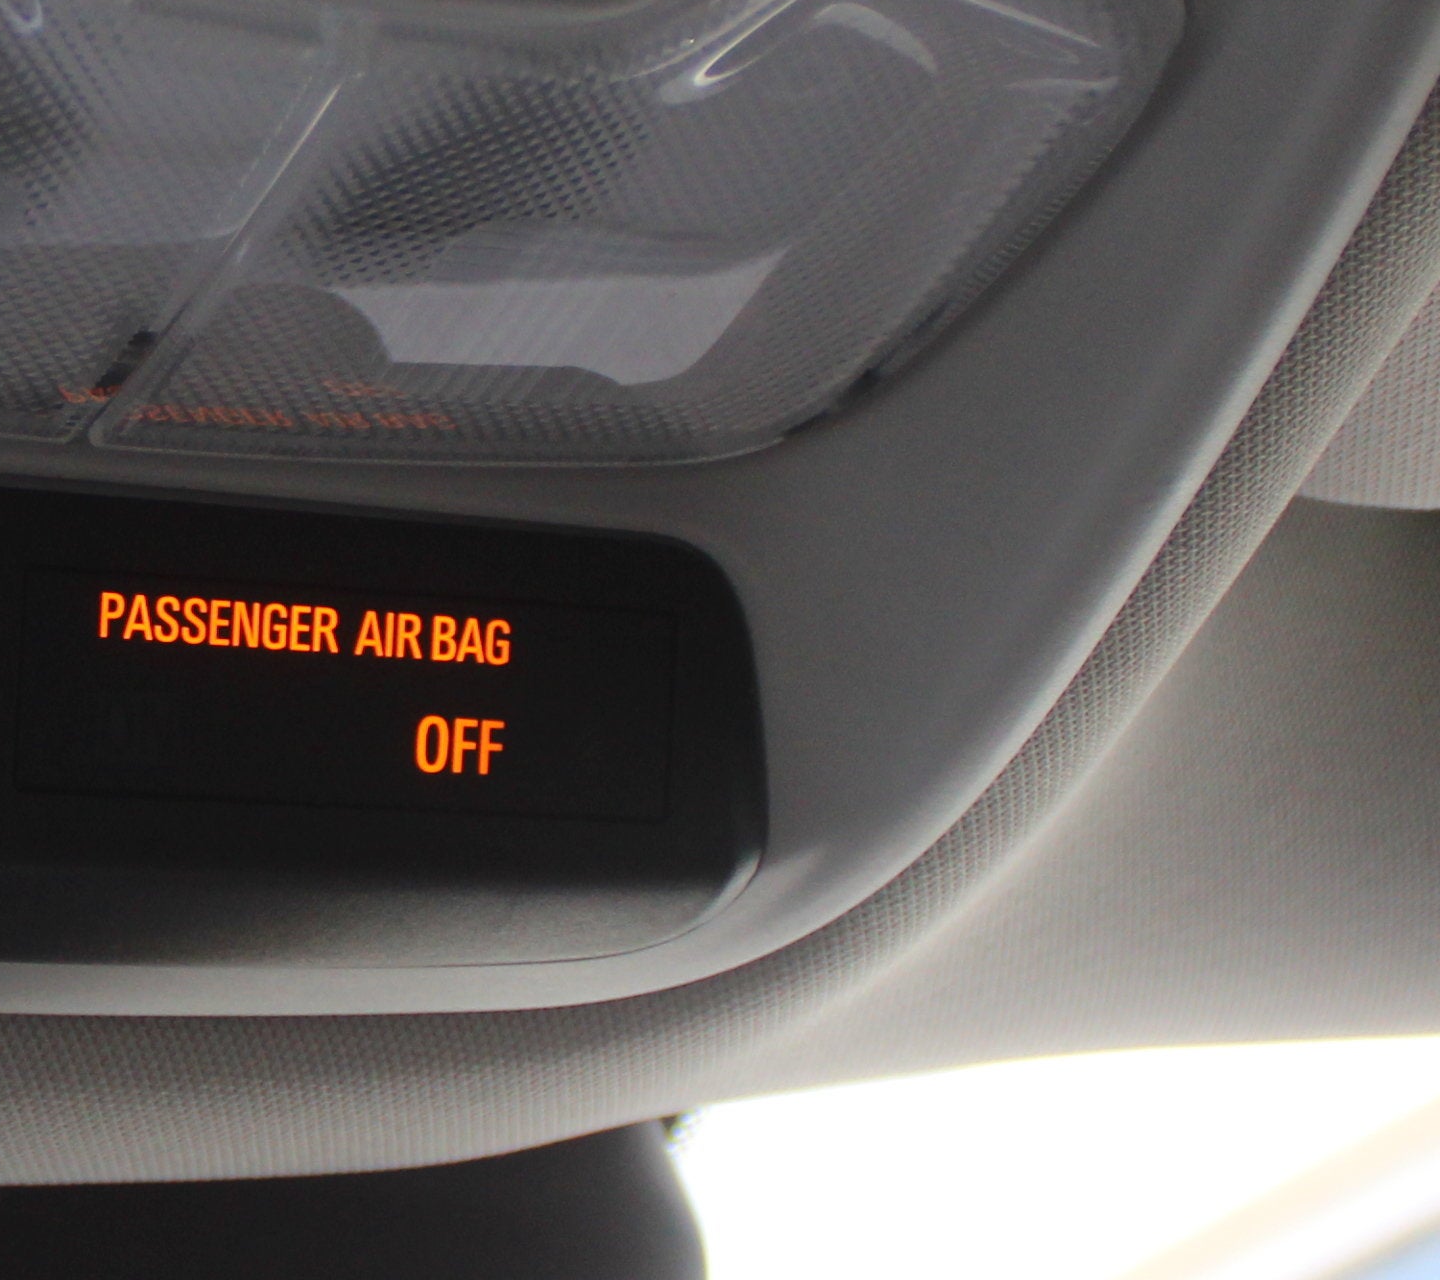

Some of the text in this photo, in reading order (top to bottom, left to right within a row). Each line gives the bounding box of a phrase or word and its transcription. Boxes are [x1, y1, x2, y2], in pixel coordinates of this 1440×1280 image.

[99, 591, 512, 667] PASSENGER AIR BAG
[415, 714, 507, 776] OFF
